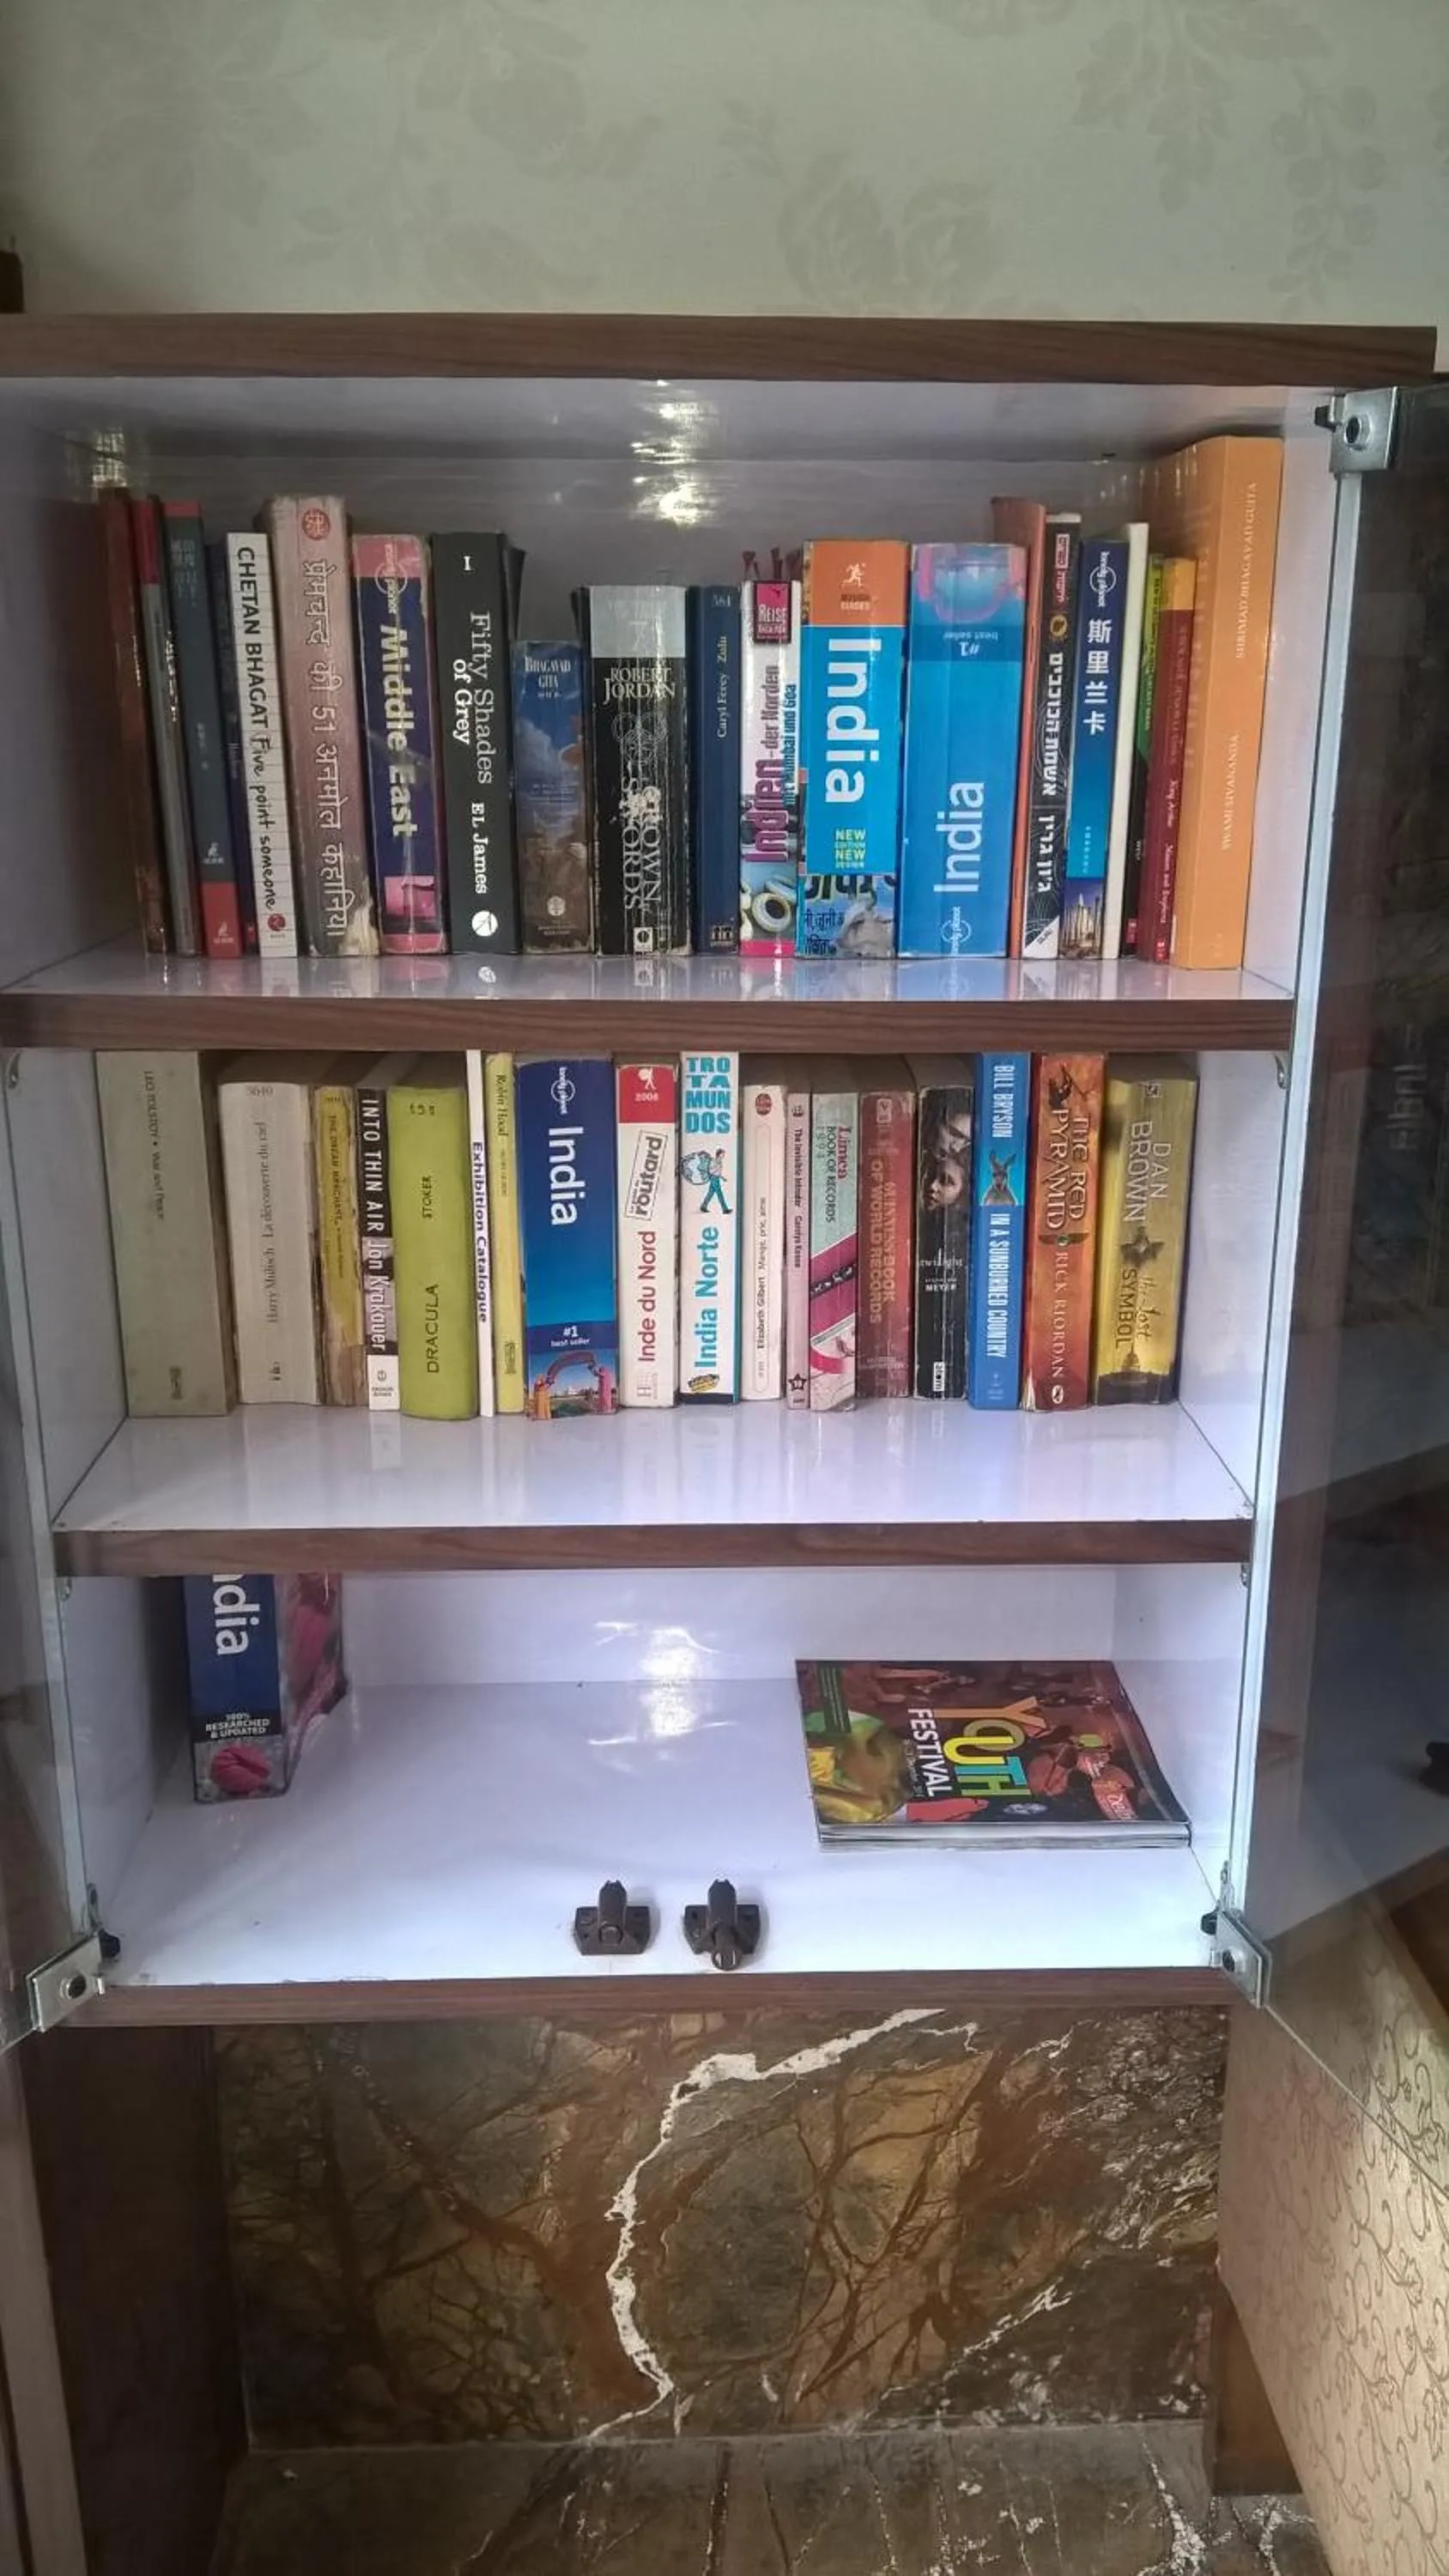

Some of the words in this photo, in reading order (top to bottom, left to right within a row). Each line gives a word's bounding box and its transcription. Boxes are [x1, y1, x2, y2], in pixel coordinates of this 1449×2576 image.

[1097, 550, 1110, 578] lonely
[236, 546, 260, 636] CHETAN
[1096, 579, 1108, 607] planet
[470, 611, 492, 682] Fifty
[716, 635, 729, 662] Zulu
[1235, 599, 1250, 659] SHRIMAD
[245, 642, 270, 731] BHAGAT
[307, 659, 345, 694] की
[379, 624, 415, 752] Middle
[452, 659, 467, 684] of
[603, 677, 676, 705] JORDAN
[609, 666, 672, 683] ROBERT
[1082, 617, 1113, 736] 斯里兰卡
[760, 665, 781, 724] Norden
[782, 683, 797, 708] Goa
[310, 704, 336, 732] 51
[452, 690, 473, 746] Grey
[473, 688, 494, 787] Shades
[716, 707, 730, 738] Caryl
[782, 710, 797, 733] und
[825, 637, 882, 803] India
[248, 731, 267, 779] Five
[782, 735, 797, 785] Mumbai
[249, 783, 273, 830] point
[314, 744, 350, 831] अनमोल
[388, 763, 419, 838] East
[742, 758, 791, 863] Indien
[1220, 809, 1234, 851] SWAMI
[834, 829, 866, 841] NEW
[834, 849, 866, 861] NEW
[932, 781, 986, 893] India
[258, 834, 277, 909] someone
[471, 832, 488, 896] James
[687, 1056, 731, 1074] TRO
[687, 1074, 731, 1089] TA
[993, 1064, 1015, 1089] BILL
[494, 1073, 507, 1105] Robin
[686, 1090, 731, 1109] MUN
[145, 1095, 160, 1139] TOLSTOY
[361, 1099, 381, 1142] INTO
[497, 1108, 510, 1138] Hood
[686, 1110, 731, 1134] DOS
[794, 1128, 803, 1143] The
[991, 1093, 1015, 1138] BRYSON
[257, 1144, 270, 1160] du
[329, 1135, 340, 1167] DREAM
[794, 1143, 803, 1176] Invisible
[826, 1126, 838, 1157] BOOK
[1070, 1115, 1090, 1161] THE
[363, 1151, 383, 1192] THIN
[472, 1141, 487, 1234] Exhibition
[547, 1125, 586, 1226] India
[634, 1135, 664, 1217] routard
[825, 1158, 836, 1173] OF
[869, 1159, 882, 1182] OF
[1040, 1108, 1071, 1230] PYRAMID
[1122, 1120, 1154, 1223] BROWN
[1149, 1142, 1172, 1199] DAN
[366, 1200, 384, 1232] AIR
[421, 1176, 433, 1220] STOKER
[825, 1175, 837, 1224] RECORDS
[869, 1184, 883, 1244] WORLD
[1069, 1171, 1088, 1220] RED
[261, 1224, 275, 1238] La
[791, 1215, 803, 1243] Carolyn
[991, 1212, 1010, 1225] IN
[263, 1247, 277, 1290] Mulisch
[367, 1238, 384, 1278] Jon
[637, 1230, 658, 1281] Nord
[694, 1226, 720, 1299] Norte
[919, 1248, 963, 1269] twilight
[987, 1239, 1009, 1307] SUNBURNED
[1054, 1251, 1069, 1293] RICK
[476, 1236, 488, 1324] Catalogue
[638, 1285, 658, 1314] du
[756, 1276, 767, 1308] Gilbert
[869, 1246, 882, 1324] RECORDS
[882, 1255, 895, 1304] BOOK
[925, 1283, 957, 1292] MEYER
[265, 1291, 280, 1323] Harry
[369, 1276, 391, 1352] Krakauer
[426, 1284, 440, 1374] DRACULA
[756, 1309, 766, 1349] Elizabeth
[1115, 1267, 1138, 1352] SYMBOL
[562, 1325, 579, 1338] #1
[637, 1315, 658, 1363] Inde
[694, 1311, 719, 1369] India
[985, 1309, 1008, 1359] COUNTRY
[1051, 1298, 1067, 1379] RIORDAN
[205, 1718, 270, 1732] RESEARCHED
[219, 1726, 267, 1738] UPDATED
[934, 1696, 1046, 1797] YOUTH
[906, 1707, 953, 1797] FESTIVAL
